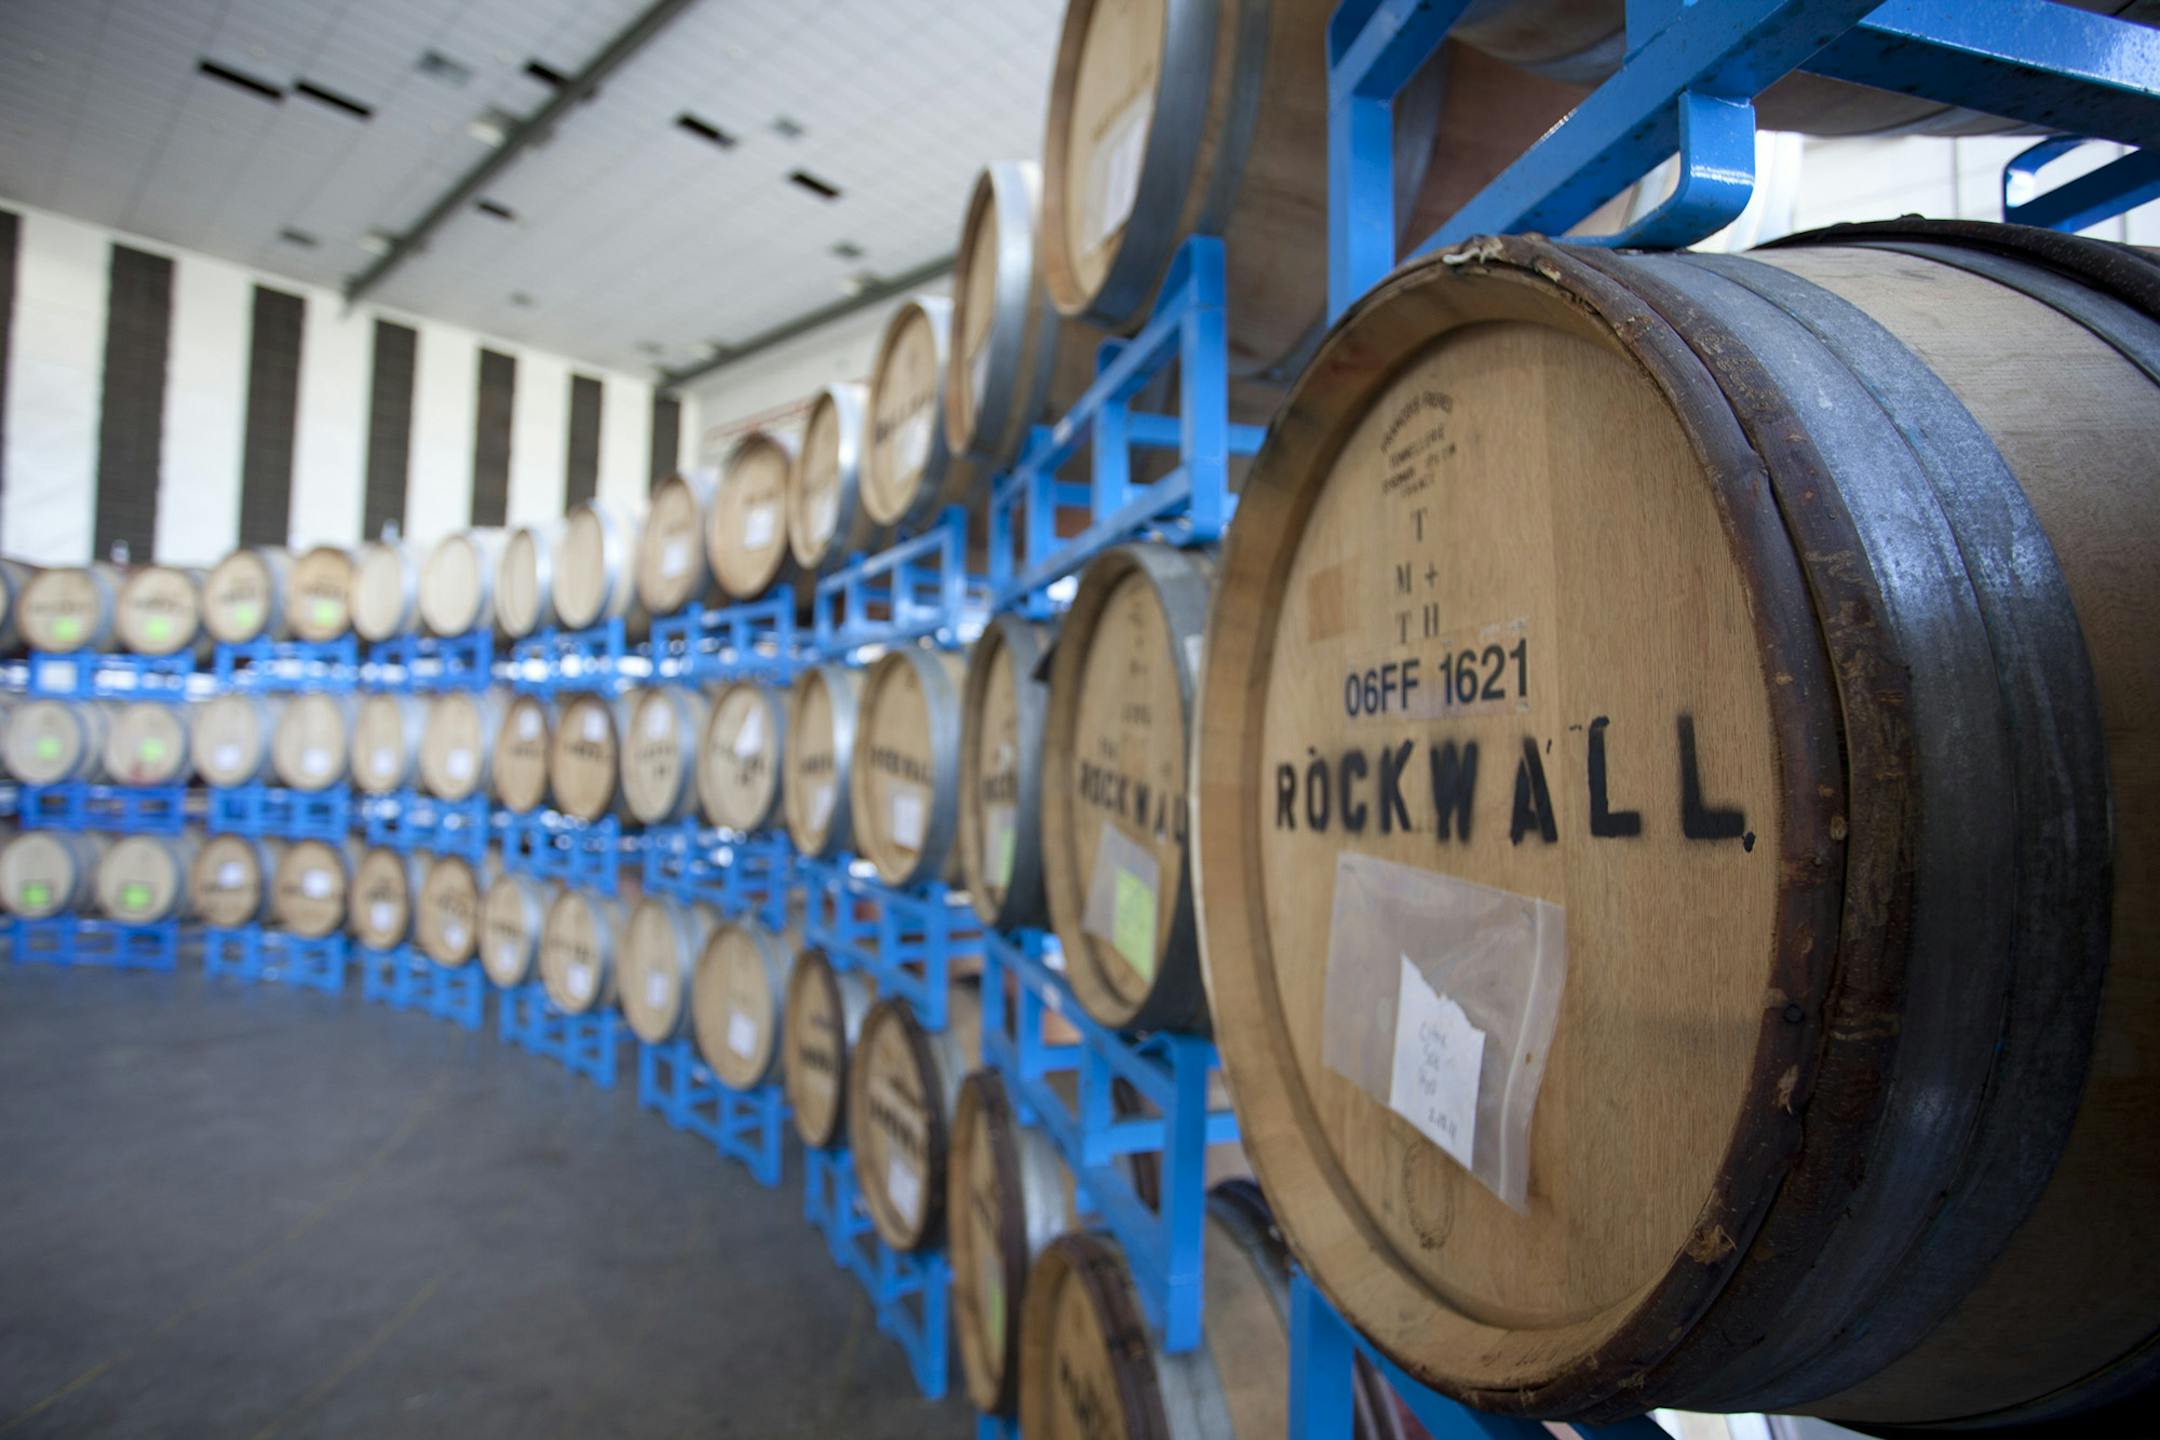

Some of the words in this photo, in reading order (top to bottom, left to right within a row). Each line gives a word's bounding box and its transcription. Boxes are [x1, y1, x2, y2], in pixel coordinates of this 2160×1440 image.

[1345, 658, 1420, 717] 06FF
[1439, 637, 1527, 706] 1621
[1276, 713, 1746, 845] ROCKWALL
